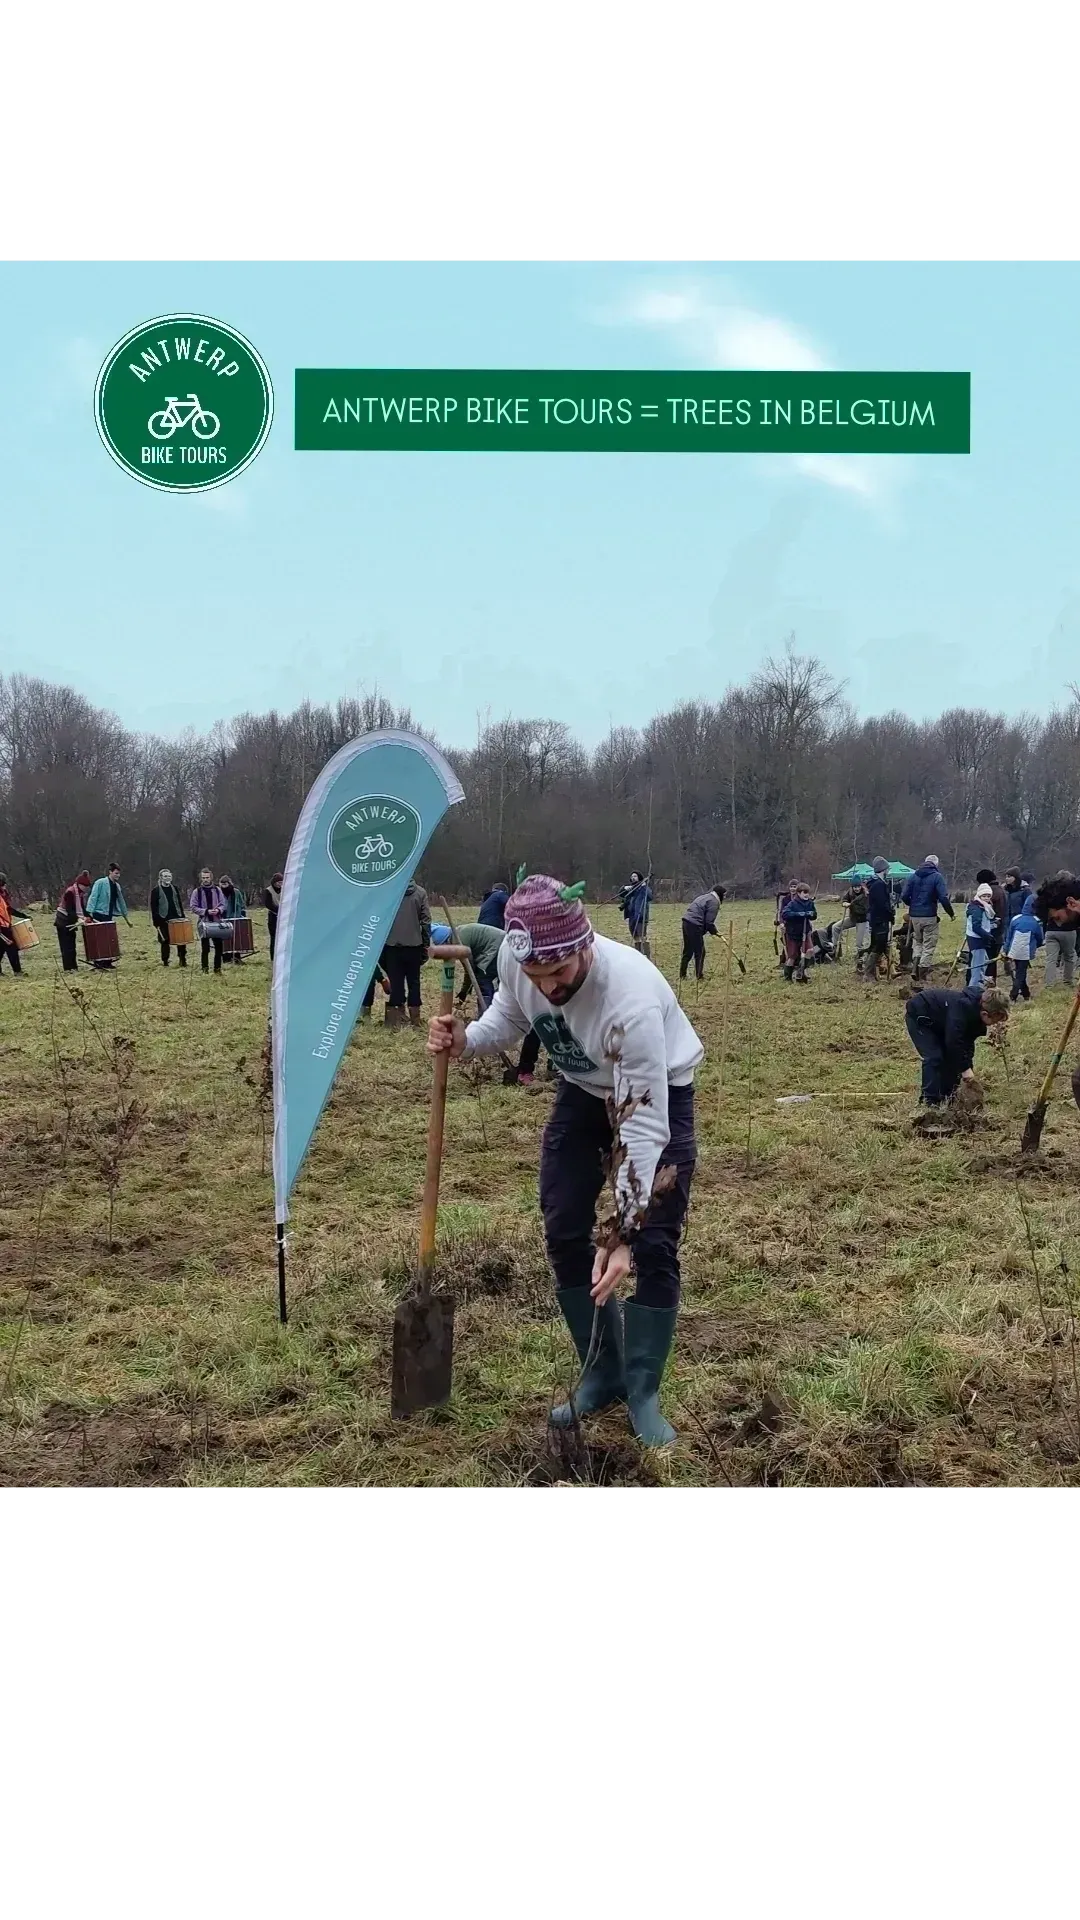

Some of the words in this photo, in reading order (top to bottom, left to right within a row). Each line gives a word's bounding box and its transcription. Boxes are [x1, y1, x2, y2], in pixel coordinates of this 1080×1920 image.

[345, 805, 407, 831] ANTWERP
[351, 862, 370, 874] BIKE
[371, 859, 397, 872] TOURS
[358, 914, 381, 941] bike
[350, 943, 371, 960] by
[331, 960, 364, 1012] Antwerp
[312, 1012, 342, 1059] Explore
